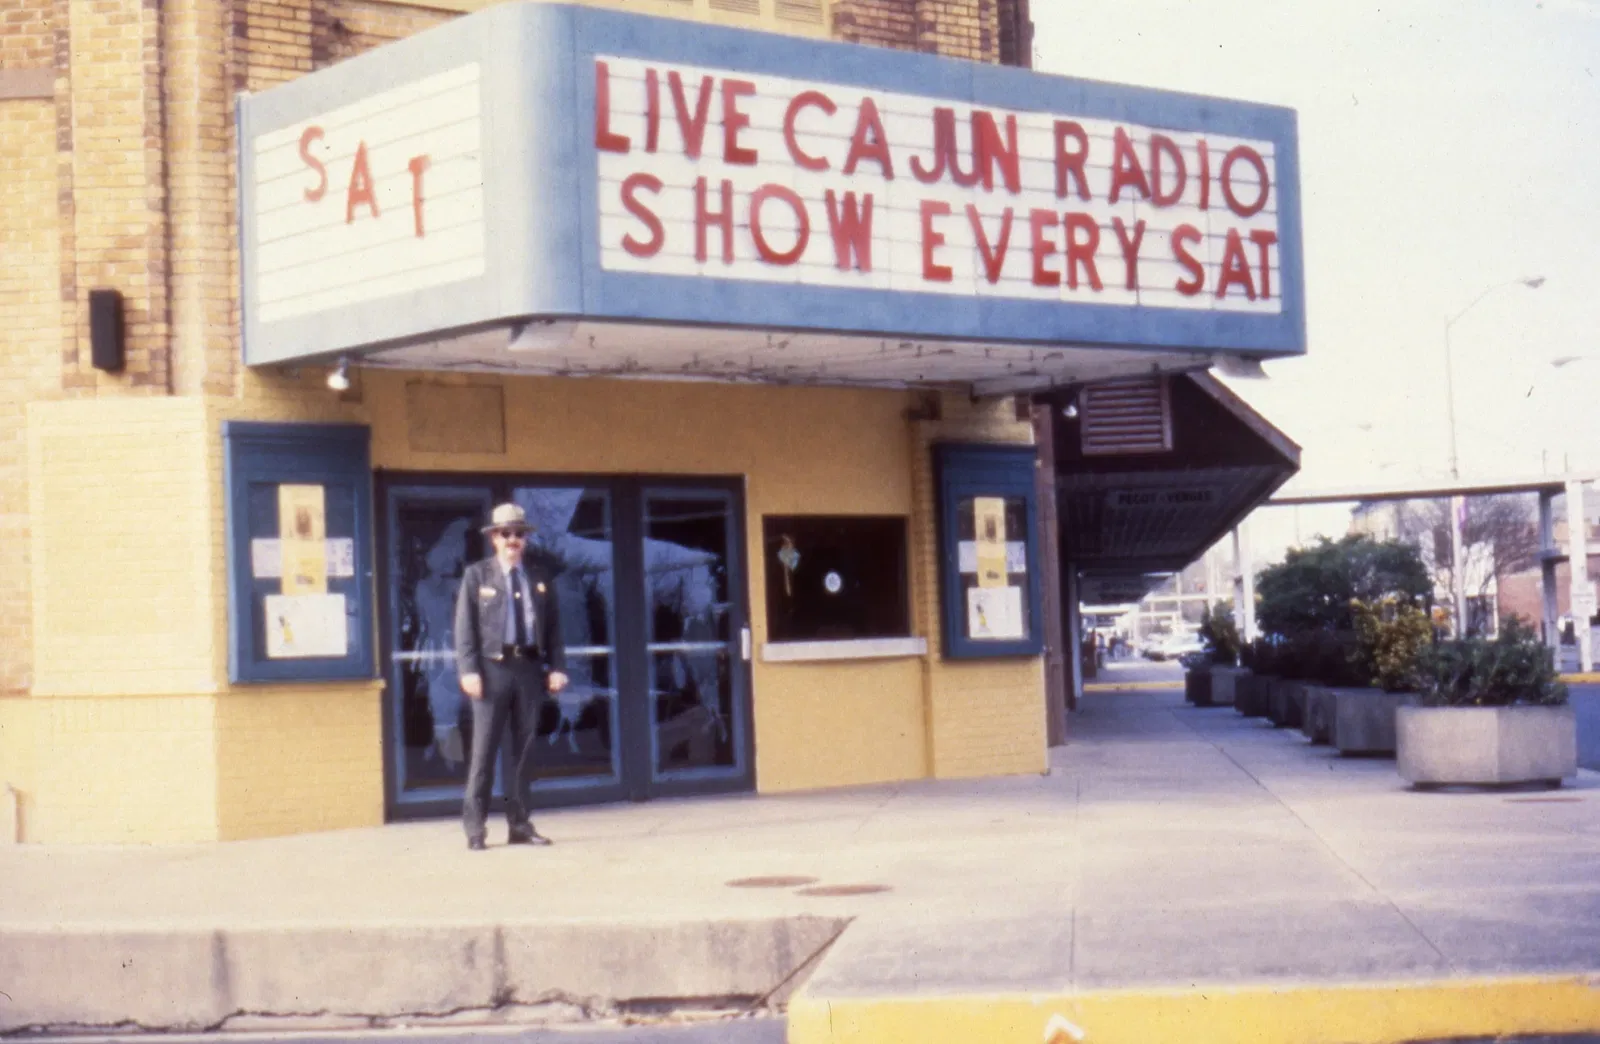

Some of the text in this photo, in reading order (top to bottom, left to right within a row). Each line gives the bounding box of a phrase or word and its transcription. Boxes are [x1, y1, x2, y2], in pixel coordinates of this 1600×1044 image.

[299, 126, 431, 238] SAT
[594, 61, 1270, 218] LIVE CAJUN RADIO
[620, 173, 1277, 300] SHOW EVERY SAT
